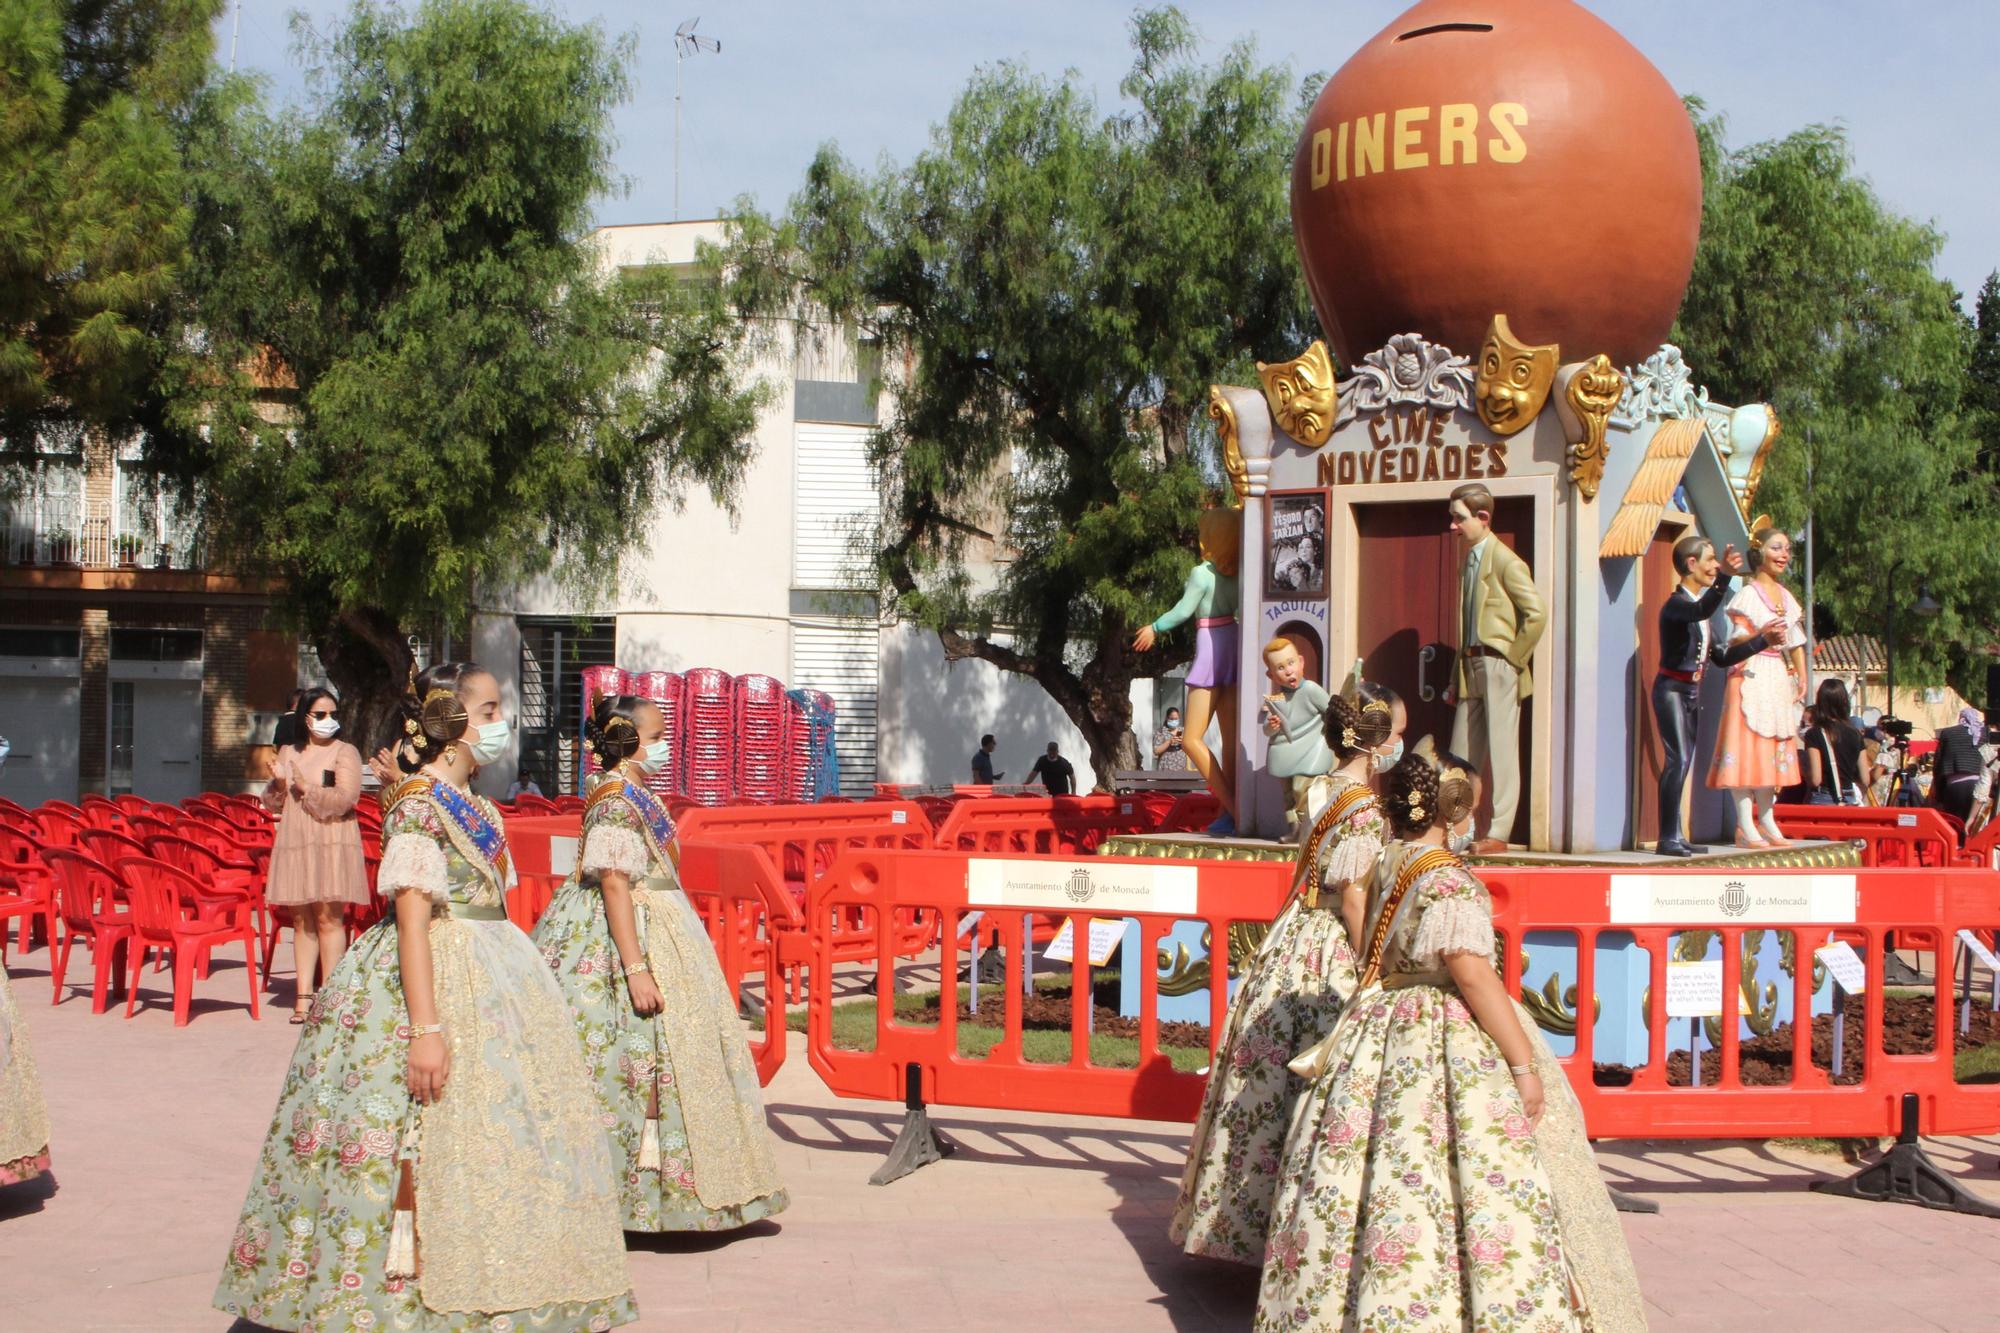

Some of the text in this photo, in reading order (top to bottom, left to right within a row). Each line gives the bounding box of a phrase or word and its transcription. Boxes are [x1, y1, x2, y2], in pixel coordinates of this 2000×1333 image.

[1311, 102, 1529, 191] DINERS
[1368, 407, 1452, 450] CINE
[1317, 441, 1508, 486] NOVEDADES
[1273, 511, 1302, 526] TESORO
[1273, 524, 1304, 540] TARZAN
[1265, 600, 1326, 621] TAQUILLA
[1005, 879, 1151, 896] Ayuntamiento de Moncada
[1654, 896, 1808, 907] Ayuntamiento de Moncada
